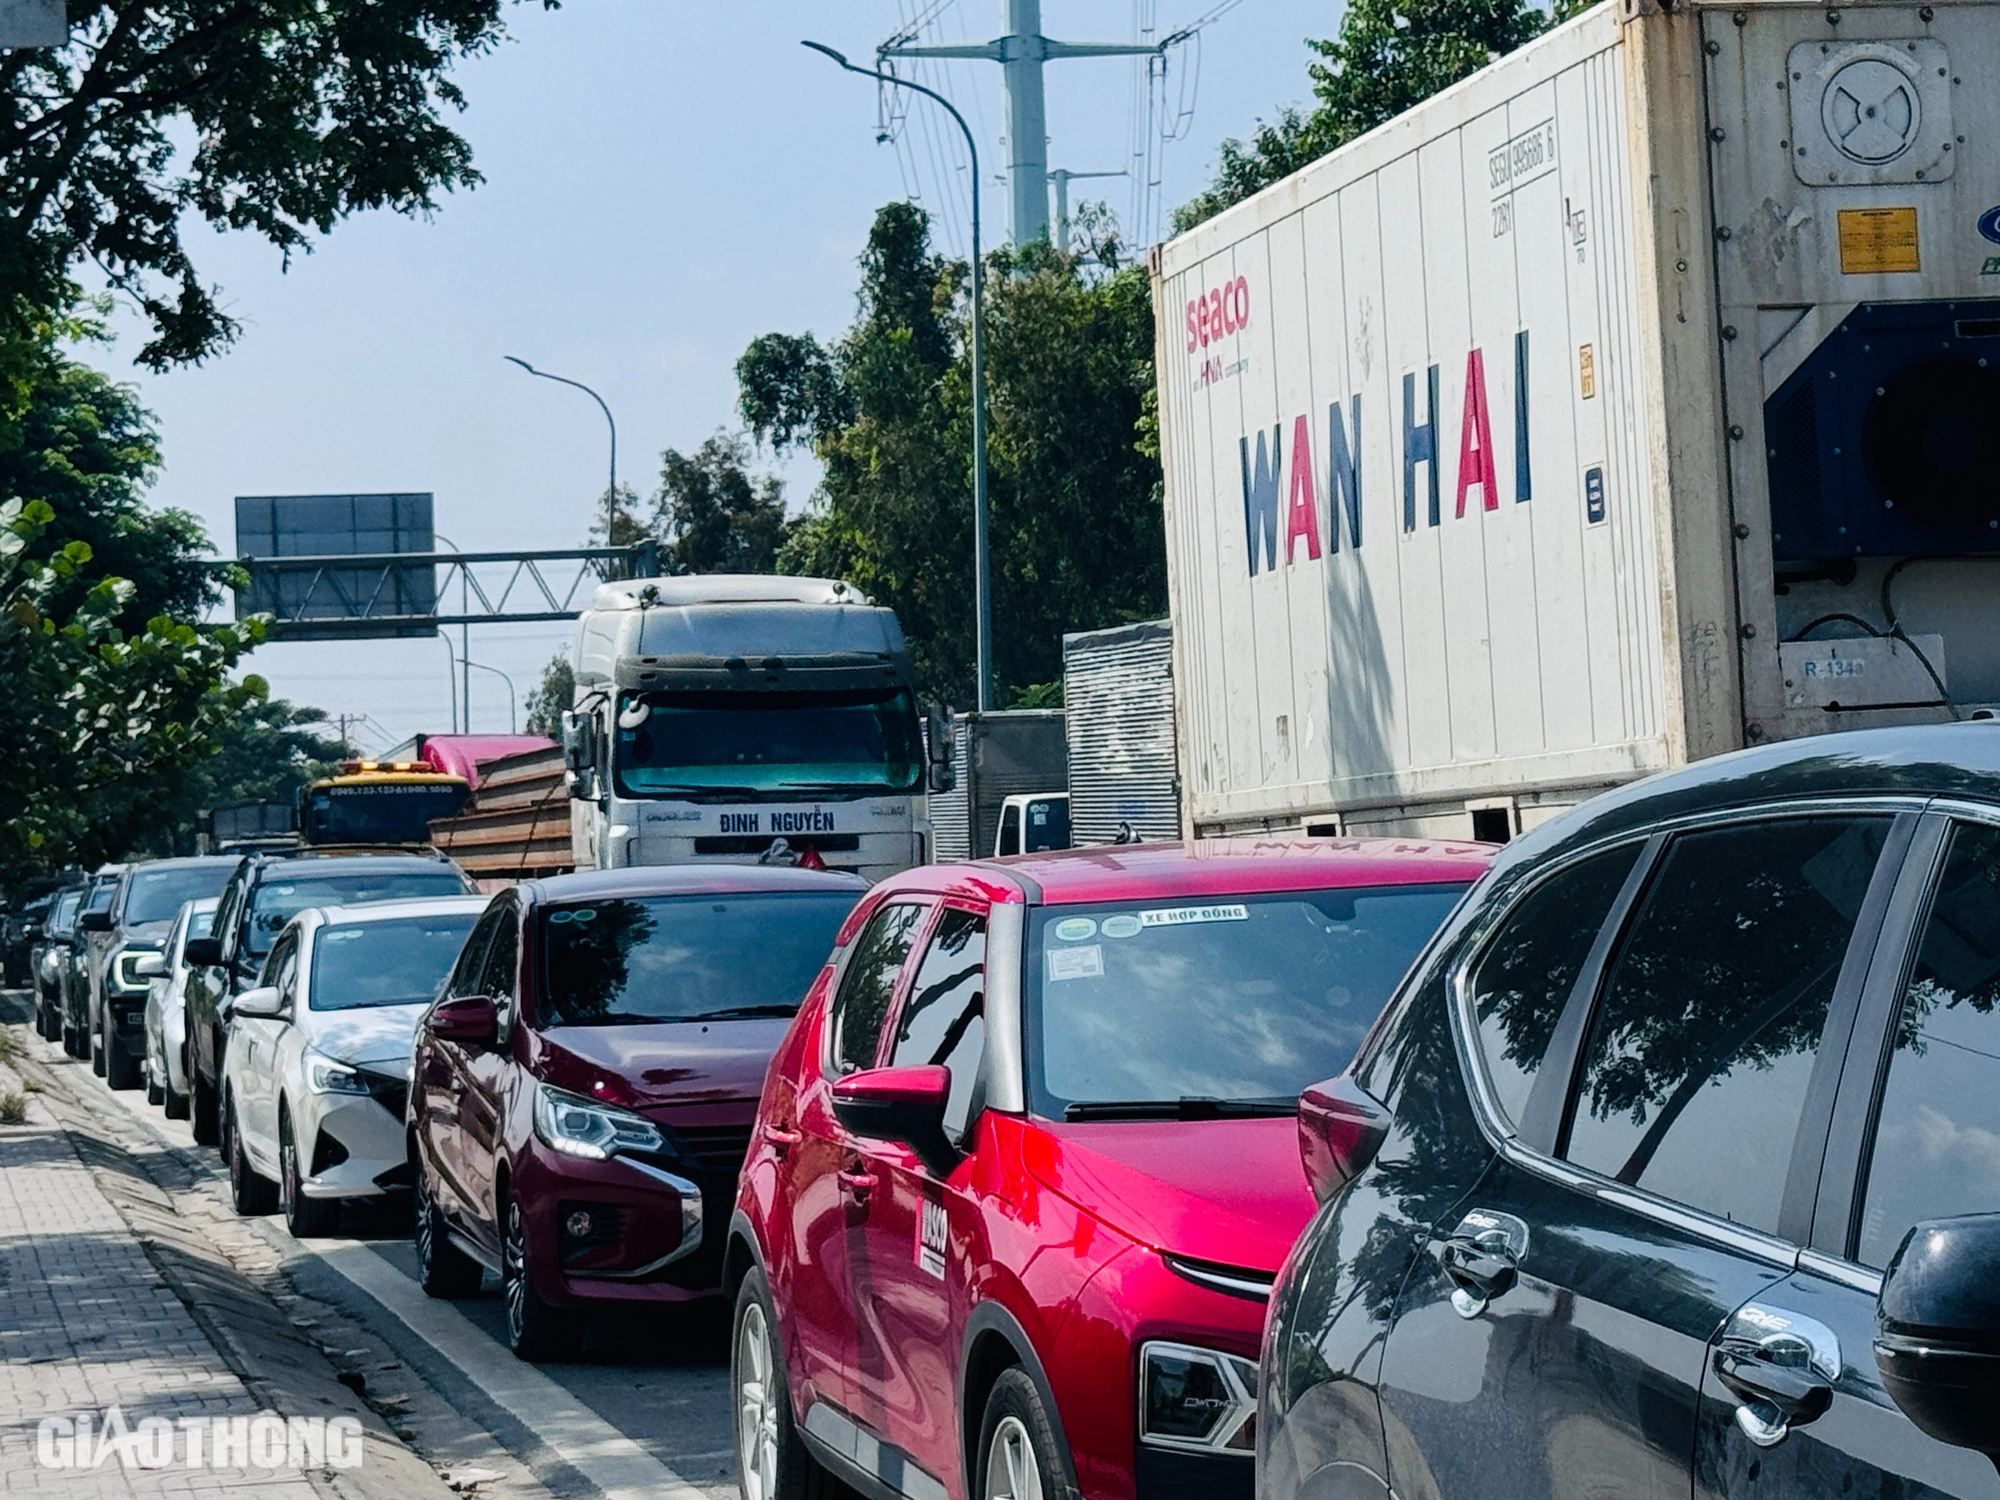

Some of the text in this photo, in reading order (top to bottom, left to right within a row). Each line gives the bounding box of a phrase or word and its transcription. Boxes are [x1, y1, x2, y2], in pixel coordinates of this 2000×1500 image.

[1547, 125, 1555, 160] 6
[1187, 275, 1249, 354] seaco
[1239, 329, 1531, 577] WAN HAI
[1145, 913, 1165, 923] XE
